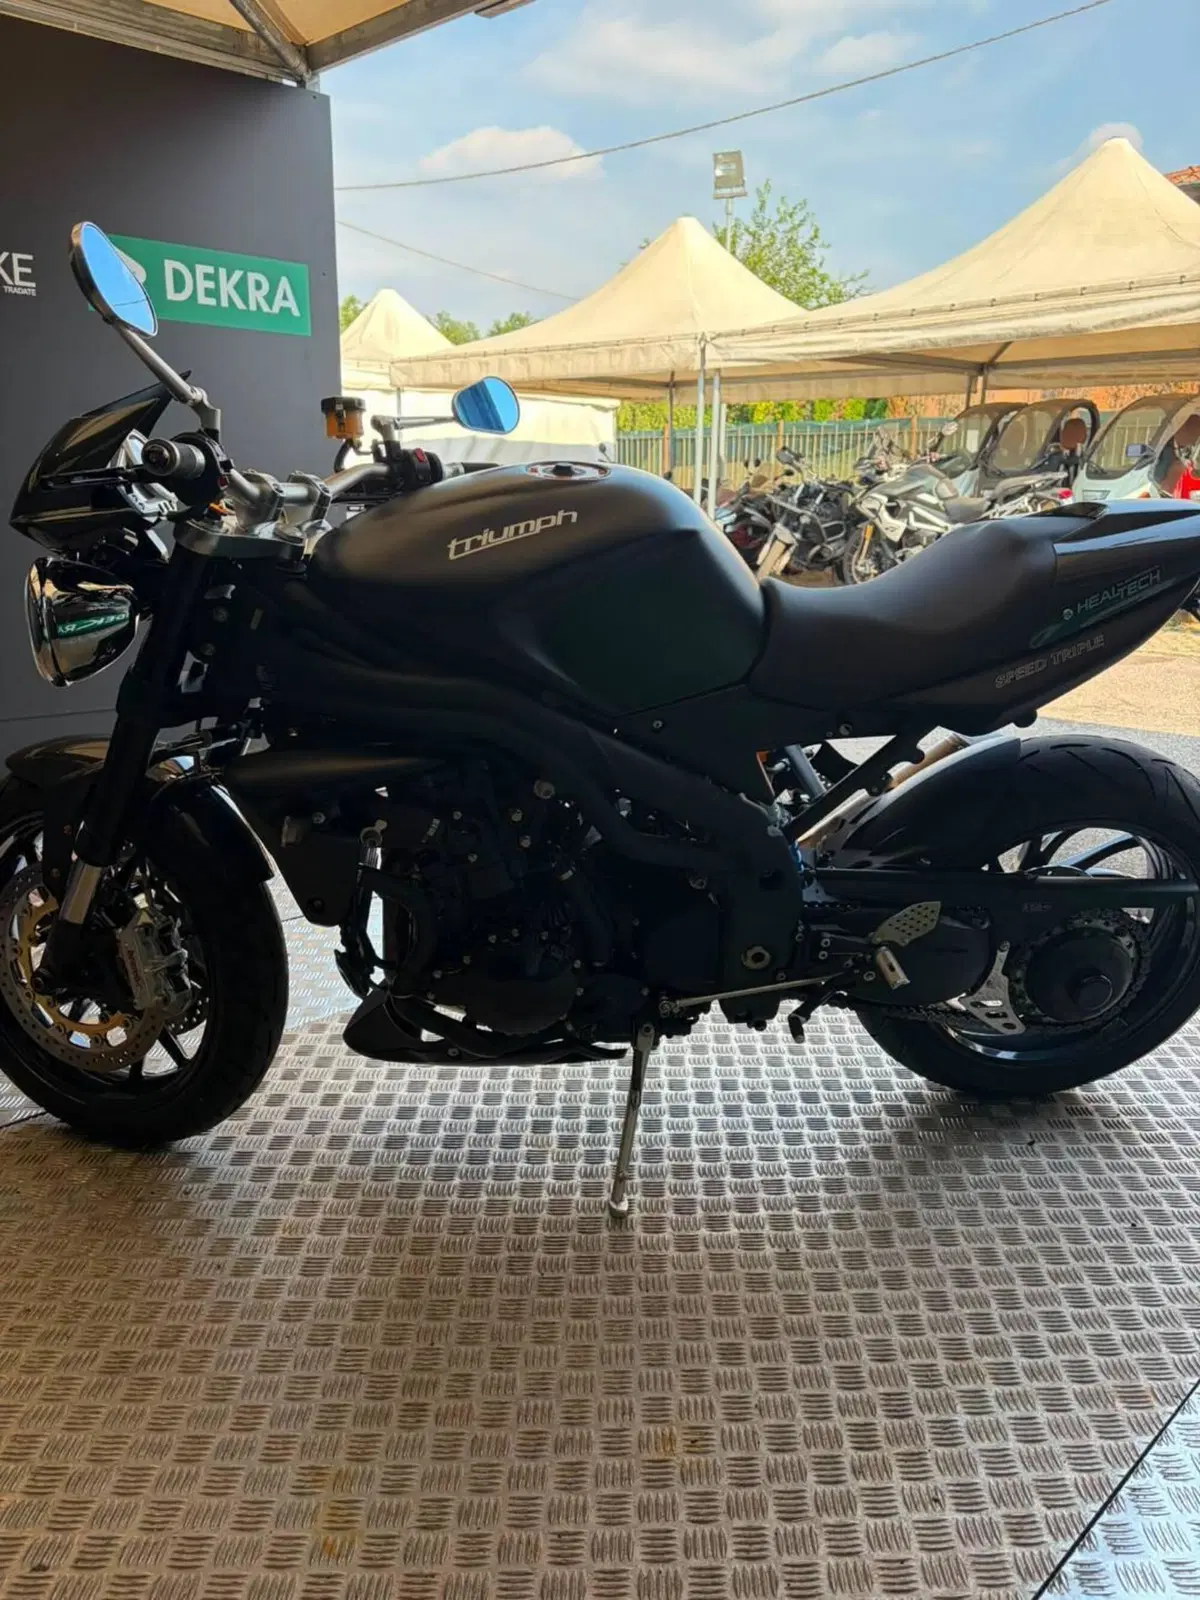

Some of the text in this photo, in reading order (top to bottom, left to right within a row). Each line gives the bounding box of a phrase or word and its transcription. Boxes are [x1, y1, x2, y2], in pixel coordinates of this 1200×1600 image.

[3, 285, 37, 296] TRADATE
[164, 259, 300, 317] DEKRA
[447, 509, 578, 560] triumph
[1077, 568, 1160, 614] HEALTECH
[995, 634, 1104, 688] SPEED TRIPLE
